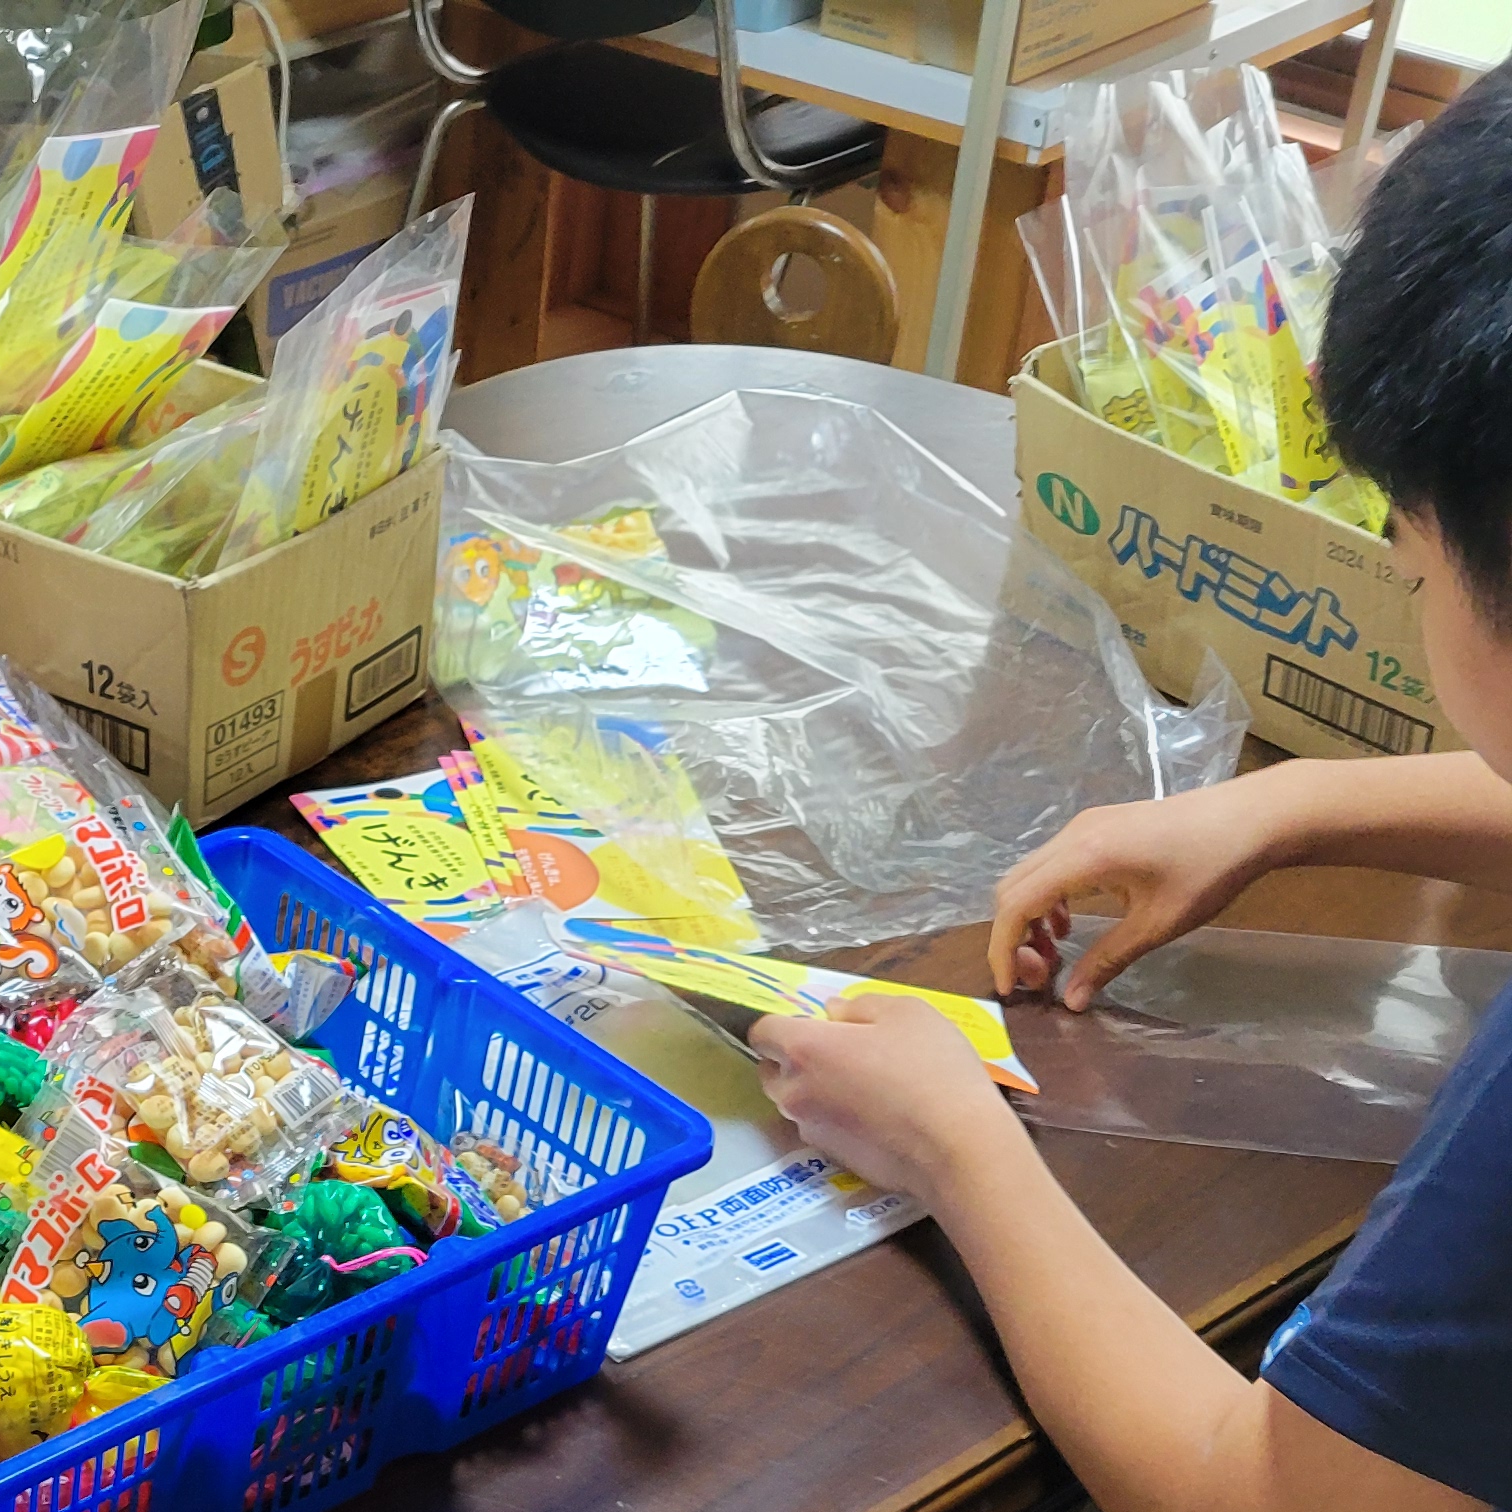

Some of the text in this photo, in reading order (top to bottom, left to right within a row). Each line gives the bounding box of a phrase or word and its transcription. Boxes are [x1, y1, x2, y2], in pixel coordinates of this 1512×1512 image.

[1108, 505, 1359, 658] ハードミント
[81, 659, 158, 717] 12袋入
[1366, 650, 1436, 704] 12袋
[213, 698, 277, 746] 01493
[73, 812, 149, 935] マゴボーロ
[360, 823, 449, 892] げんき
